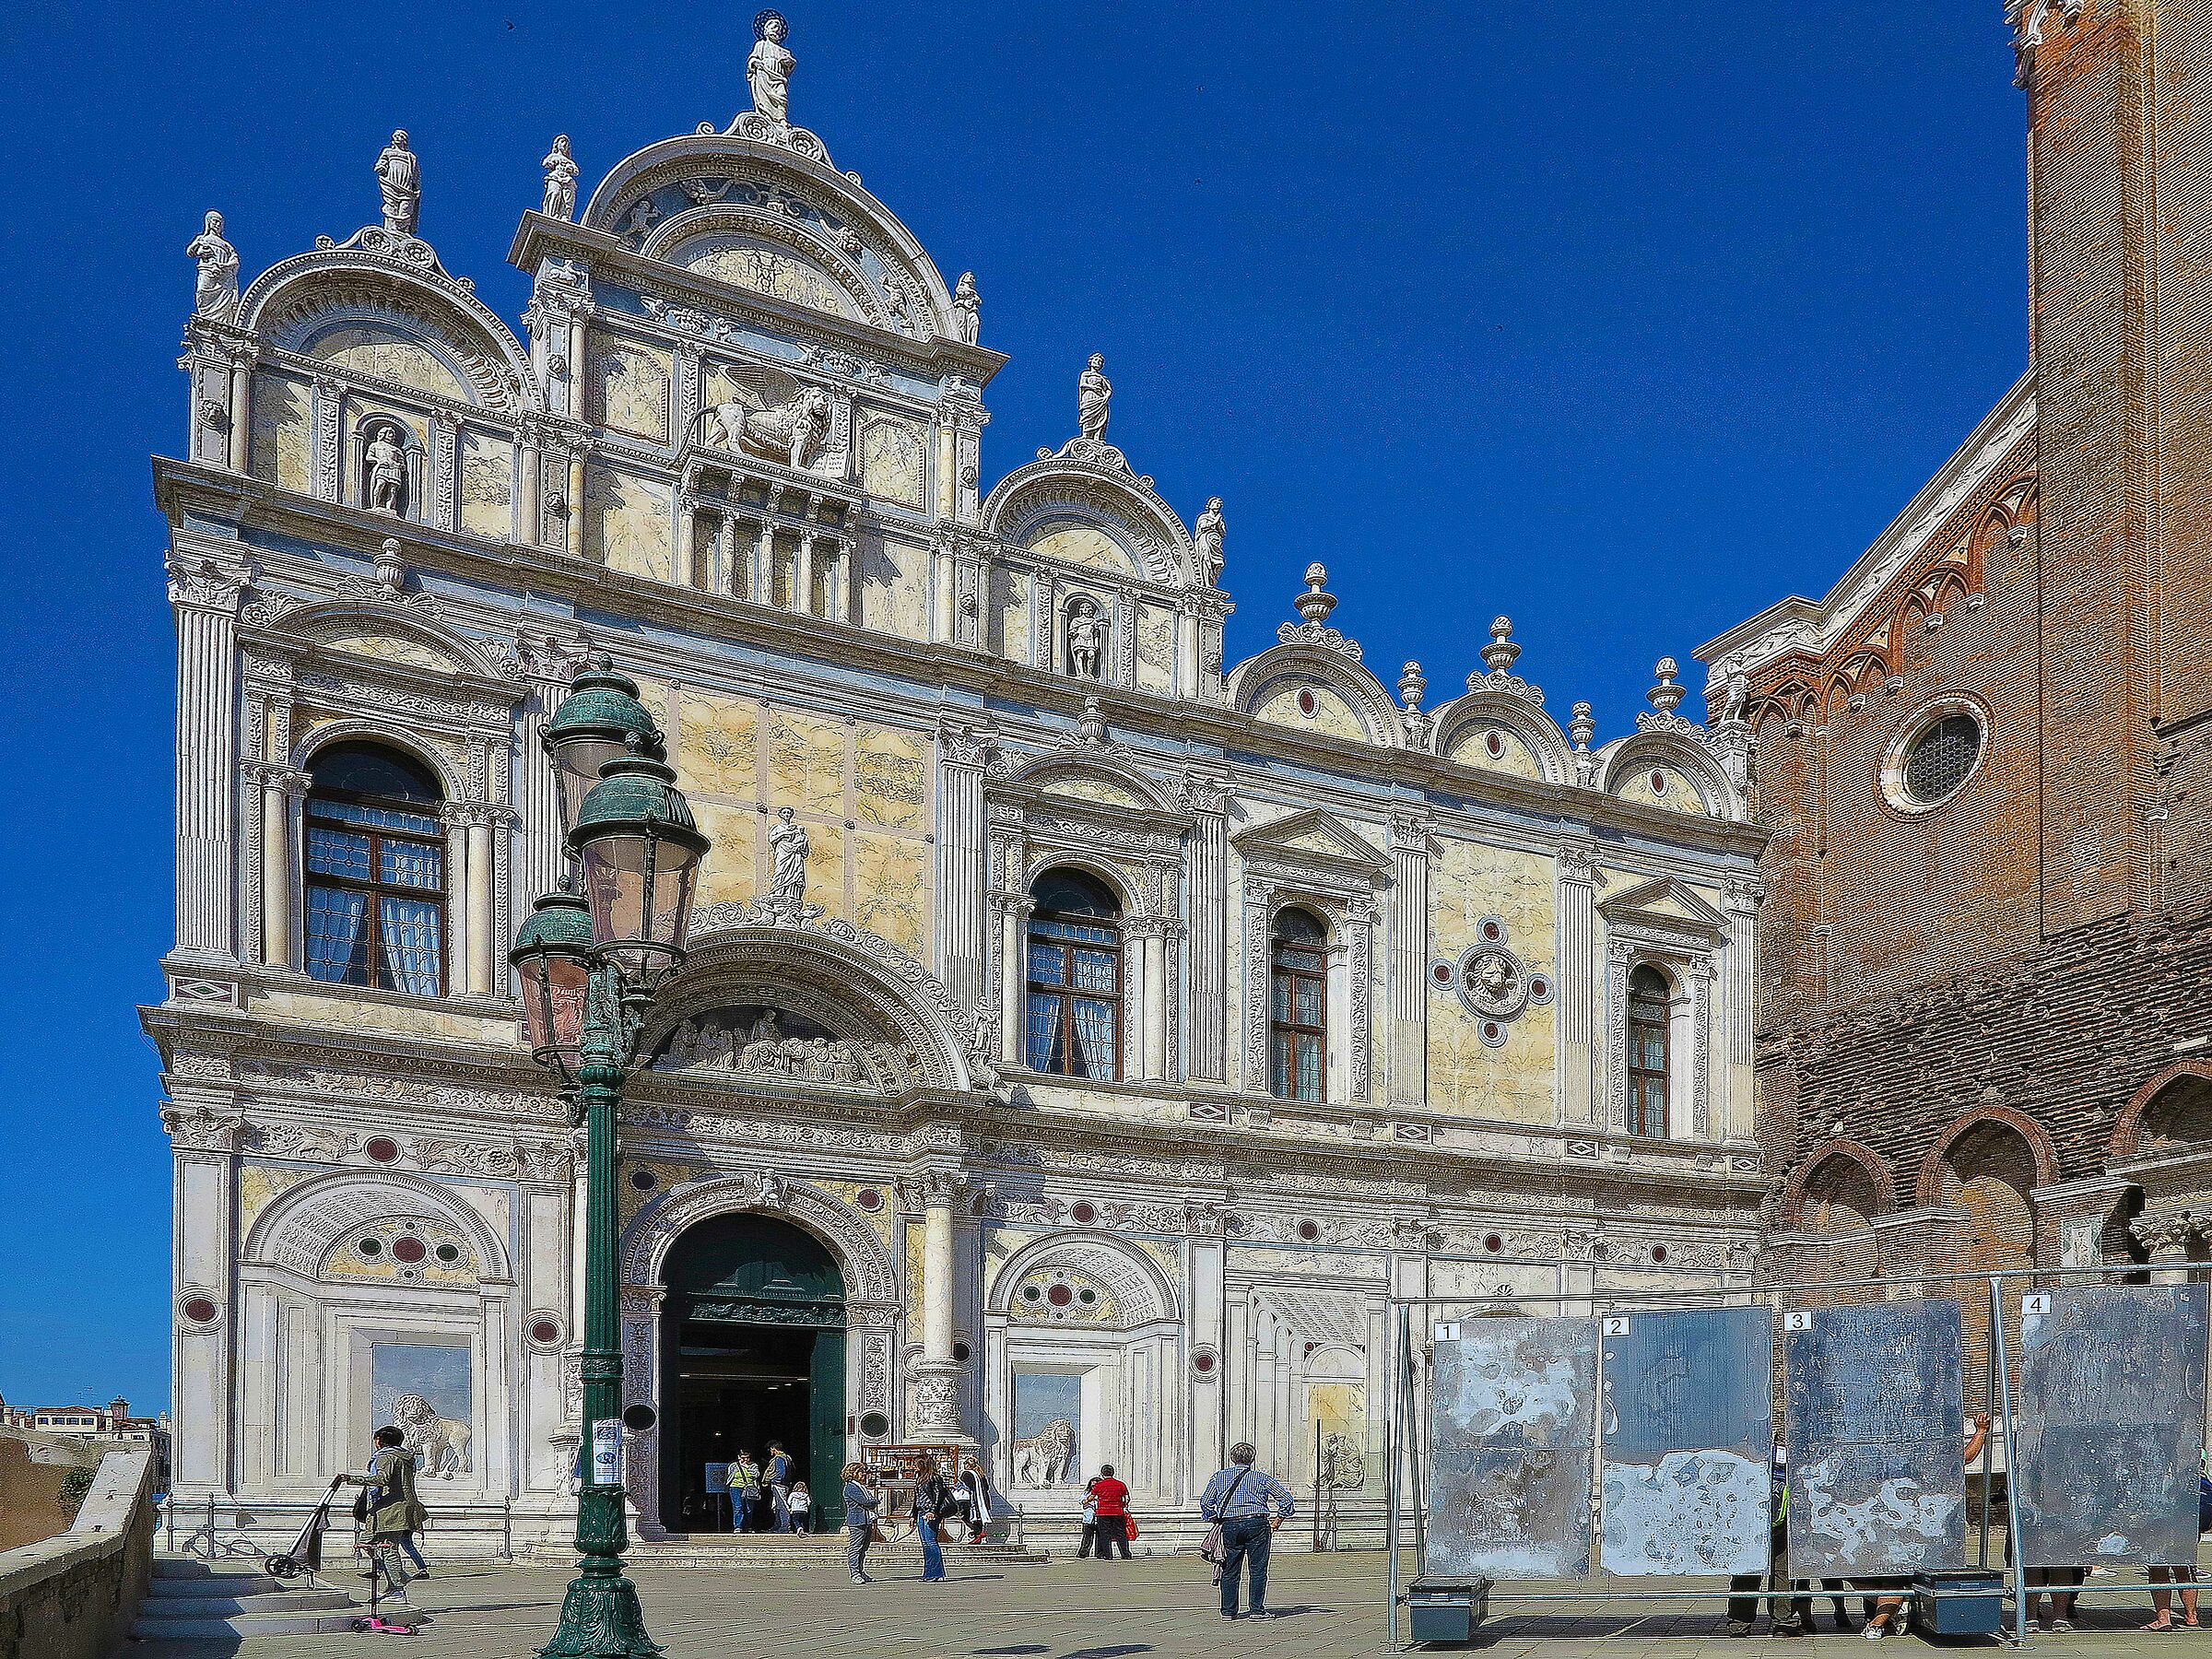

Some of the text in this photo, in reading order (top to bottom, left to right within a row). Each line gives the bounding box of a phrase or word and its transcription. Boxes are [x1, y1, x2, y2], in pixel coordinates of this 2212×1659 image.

[2030, 1297, 2042, 1312] 4
[1610, 1319, 1622, 1335] 2
[1792, 1313, 1804, 1329] 3
[1442, 1324, 1450, 1339] 1
